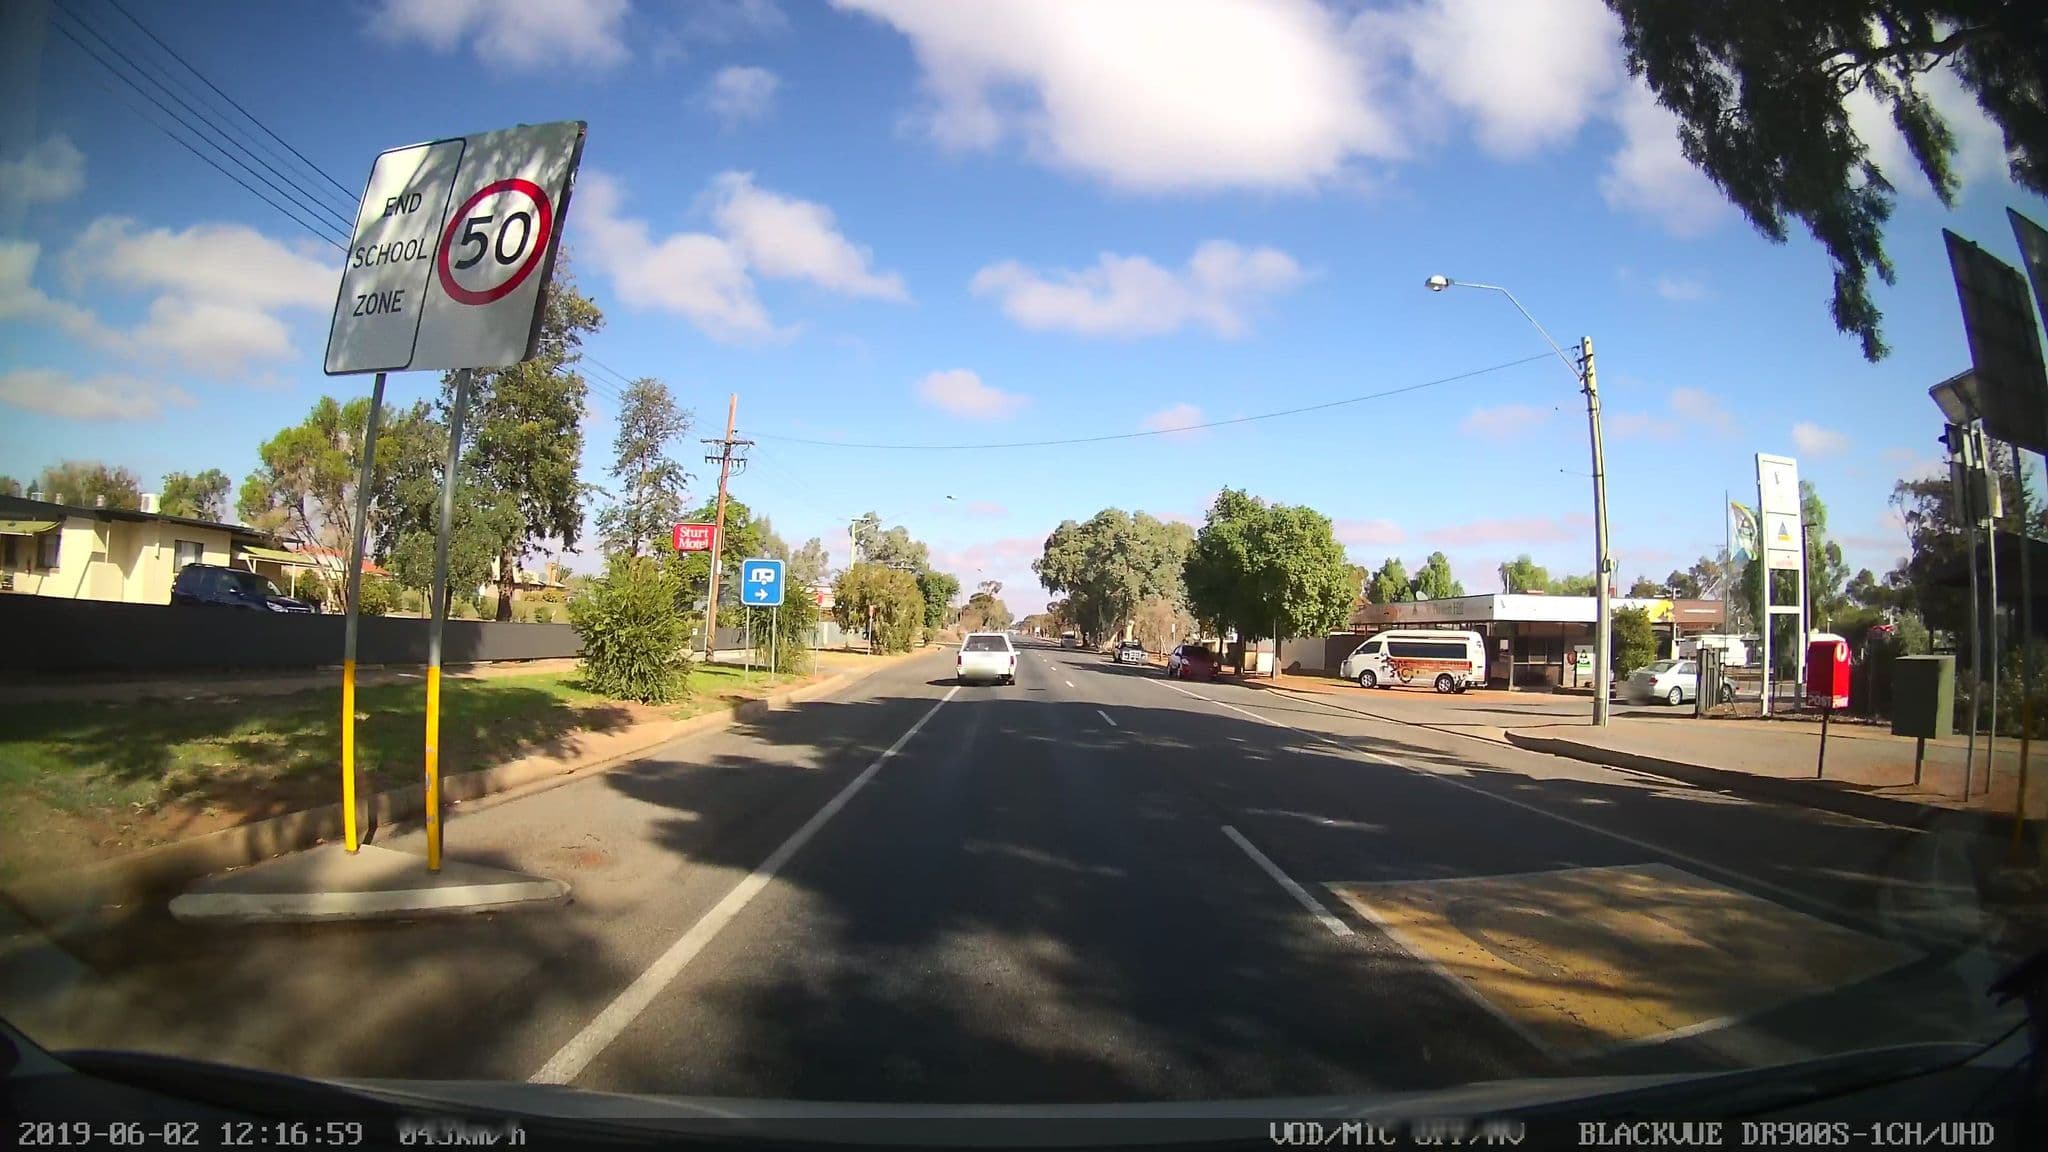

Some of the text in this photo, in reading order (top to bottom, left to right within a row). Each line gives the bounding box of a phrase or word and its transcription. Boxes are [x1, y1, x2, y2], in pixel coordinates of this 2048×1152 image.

[383, 192, 422, 218] END
[352, 238, 427, 269] SCHOOL
[454, 211, 531, 270] 50
[353, 290, 405, 317] ZONE
[679, 538, 709, 549] Motel
[680, 526, 709, 538] Sturt
